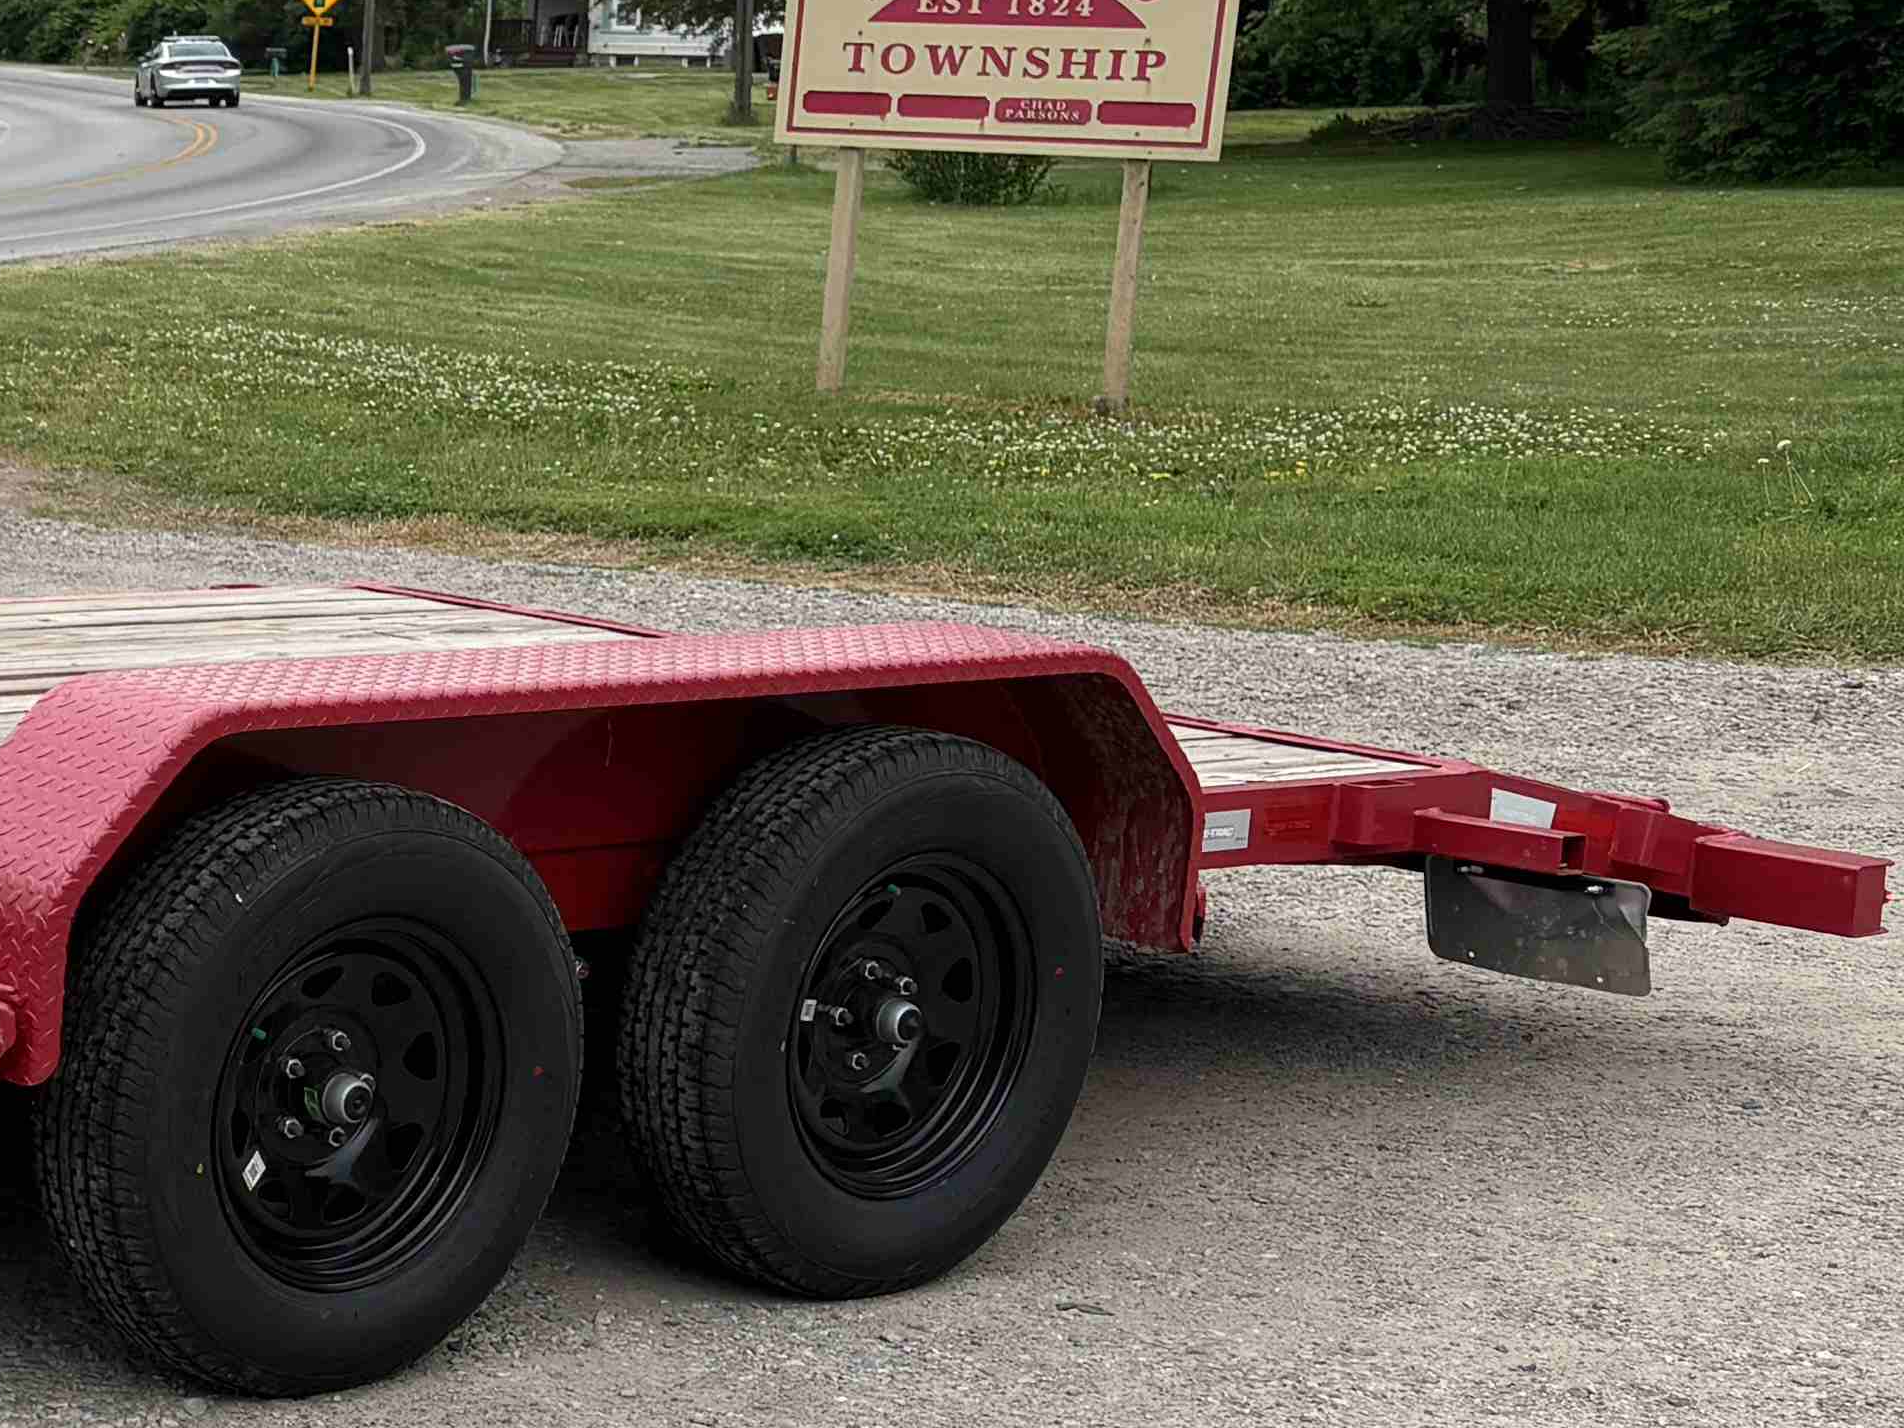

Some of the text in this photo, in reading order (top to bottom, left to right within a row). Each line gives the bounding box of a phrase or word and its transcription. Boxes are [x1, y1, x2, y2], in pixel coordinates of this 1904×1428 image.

[842, 41, 1168, 83] TOWNSHIP
[1020, 99, 1067, 112] CHAD
[1005, 108, 1081, 122] PARSONS
